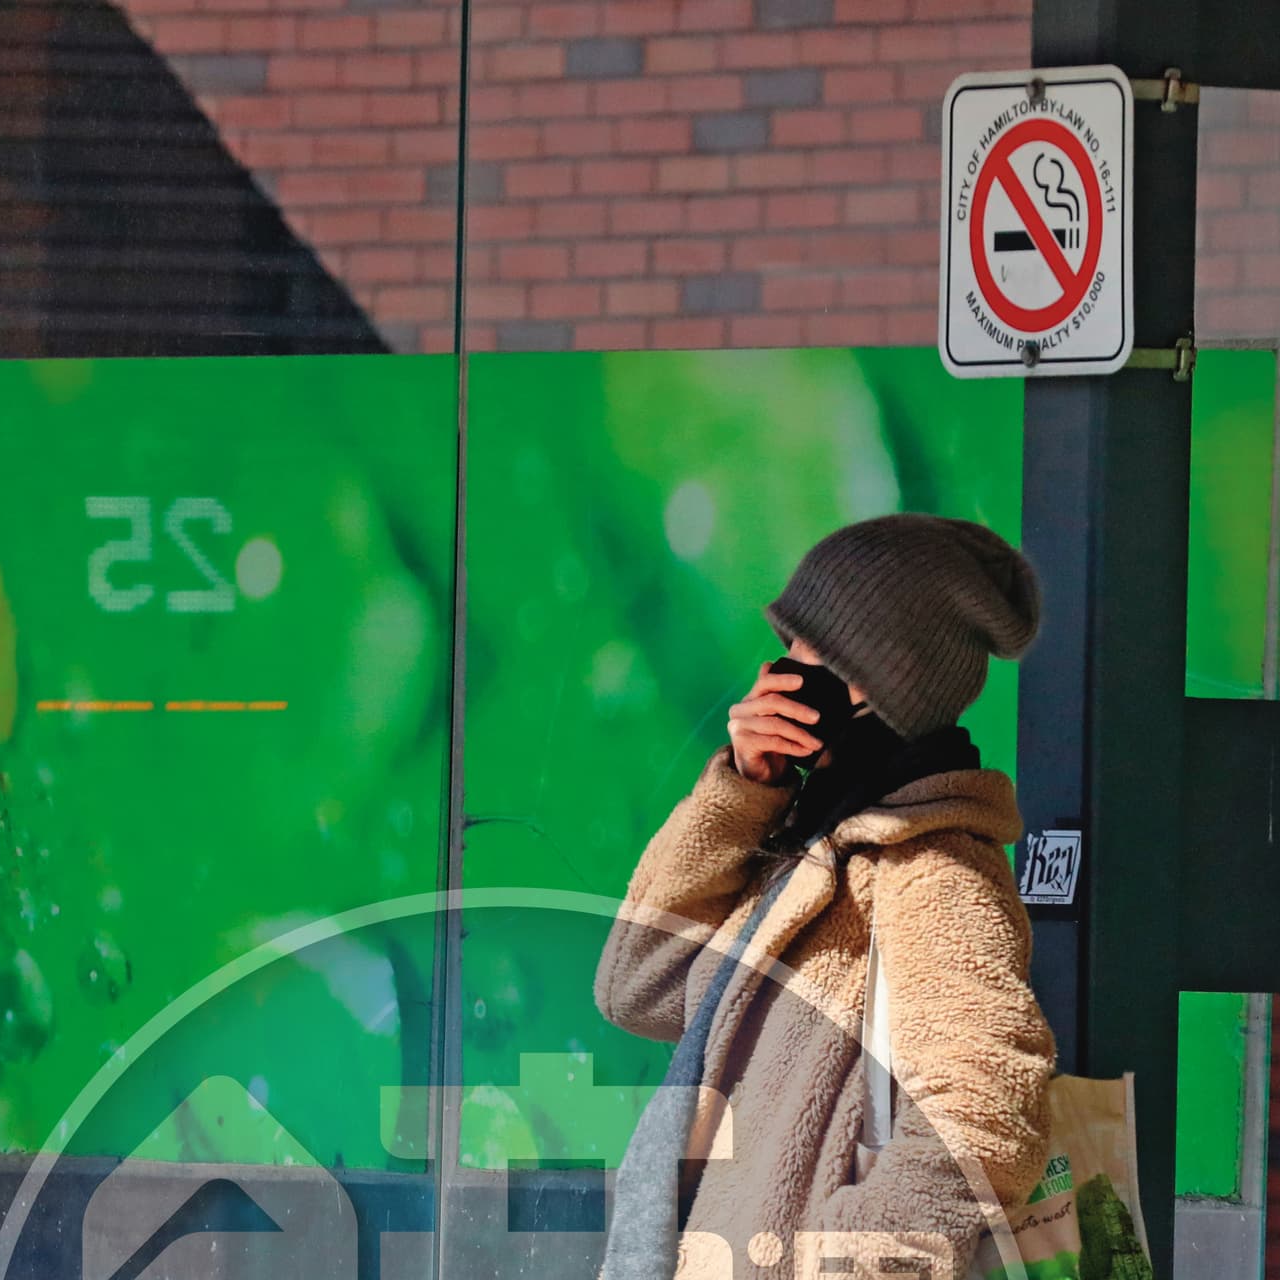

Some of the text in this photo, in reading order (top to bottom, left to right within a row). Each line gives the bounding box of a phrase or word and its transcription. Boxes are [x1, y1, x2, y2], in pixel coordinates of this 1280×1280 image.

[957, 99, 1116, 221] CITY OF HAMILTON BY-LAW NO. 16-111
[965, 290, 1014, 350] MAXIMUM
